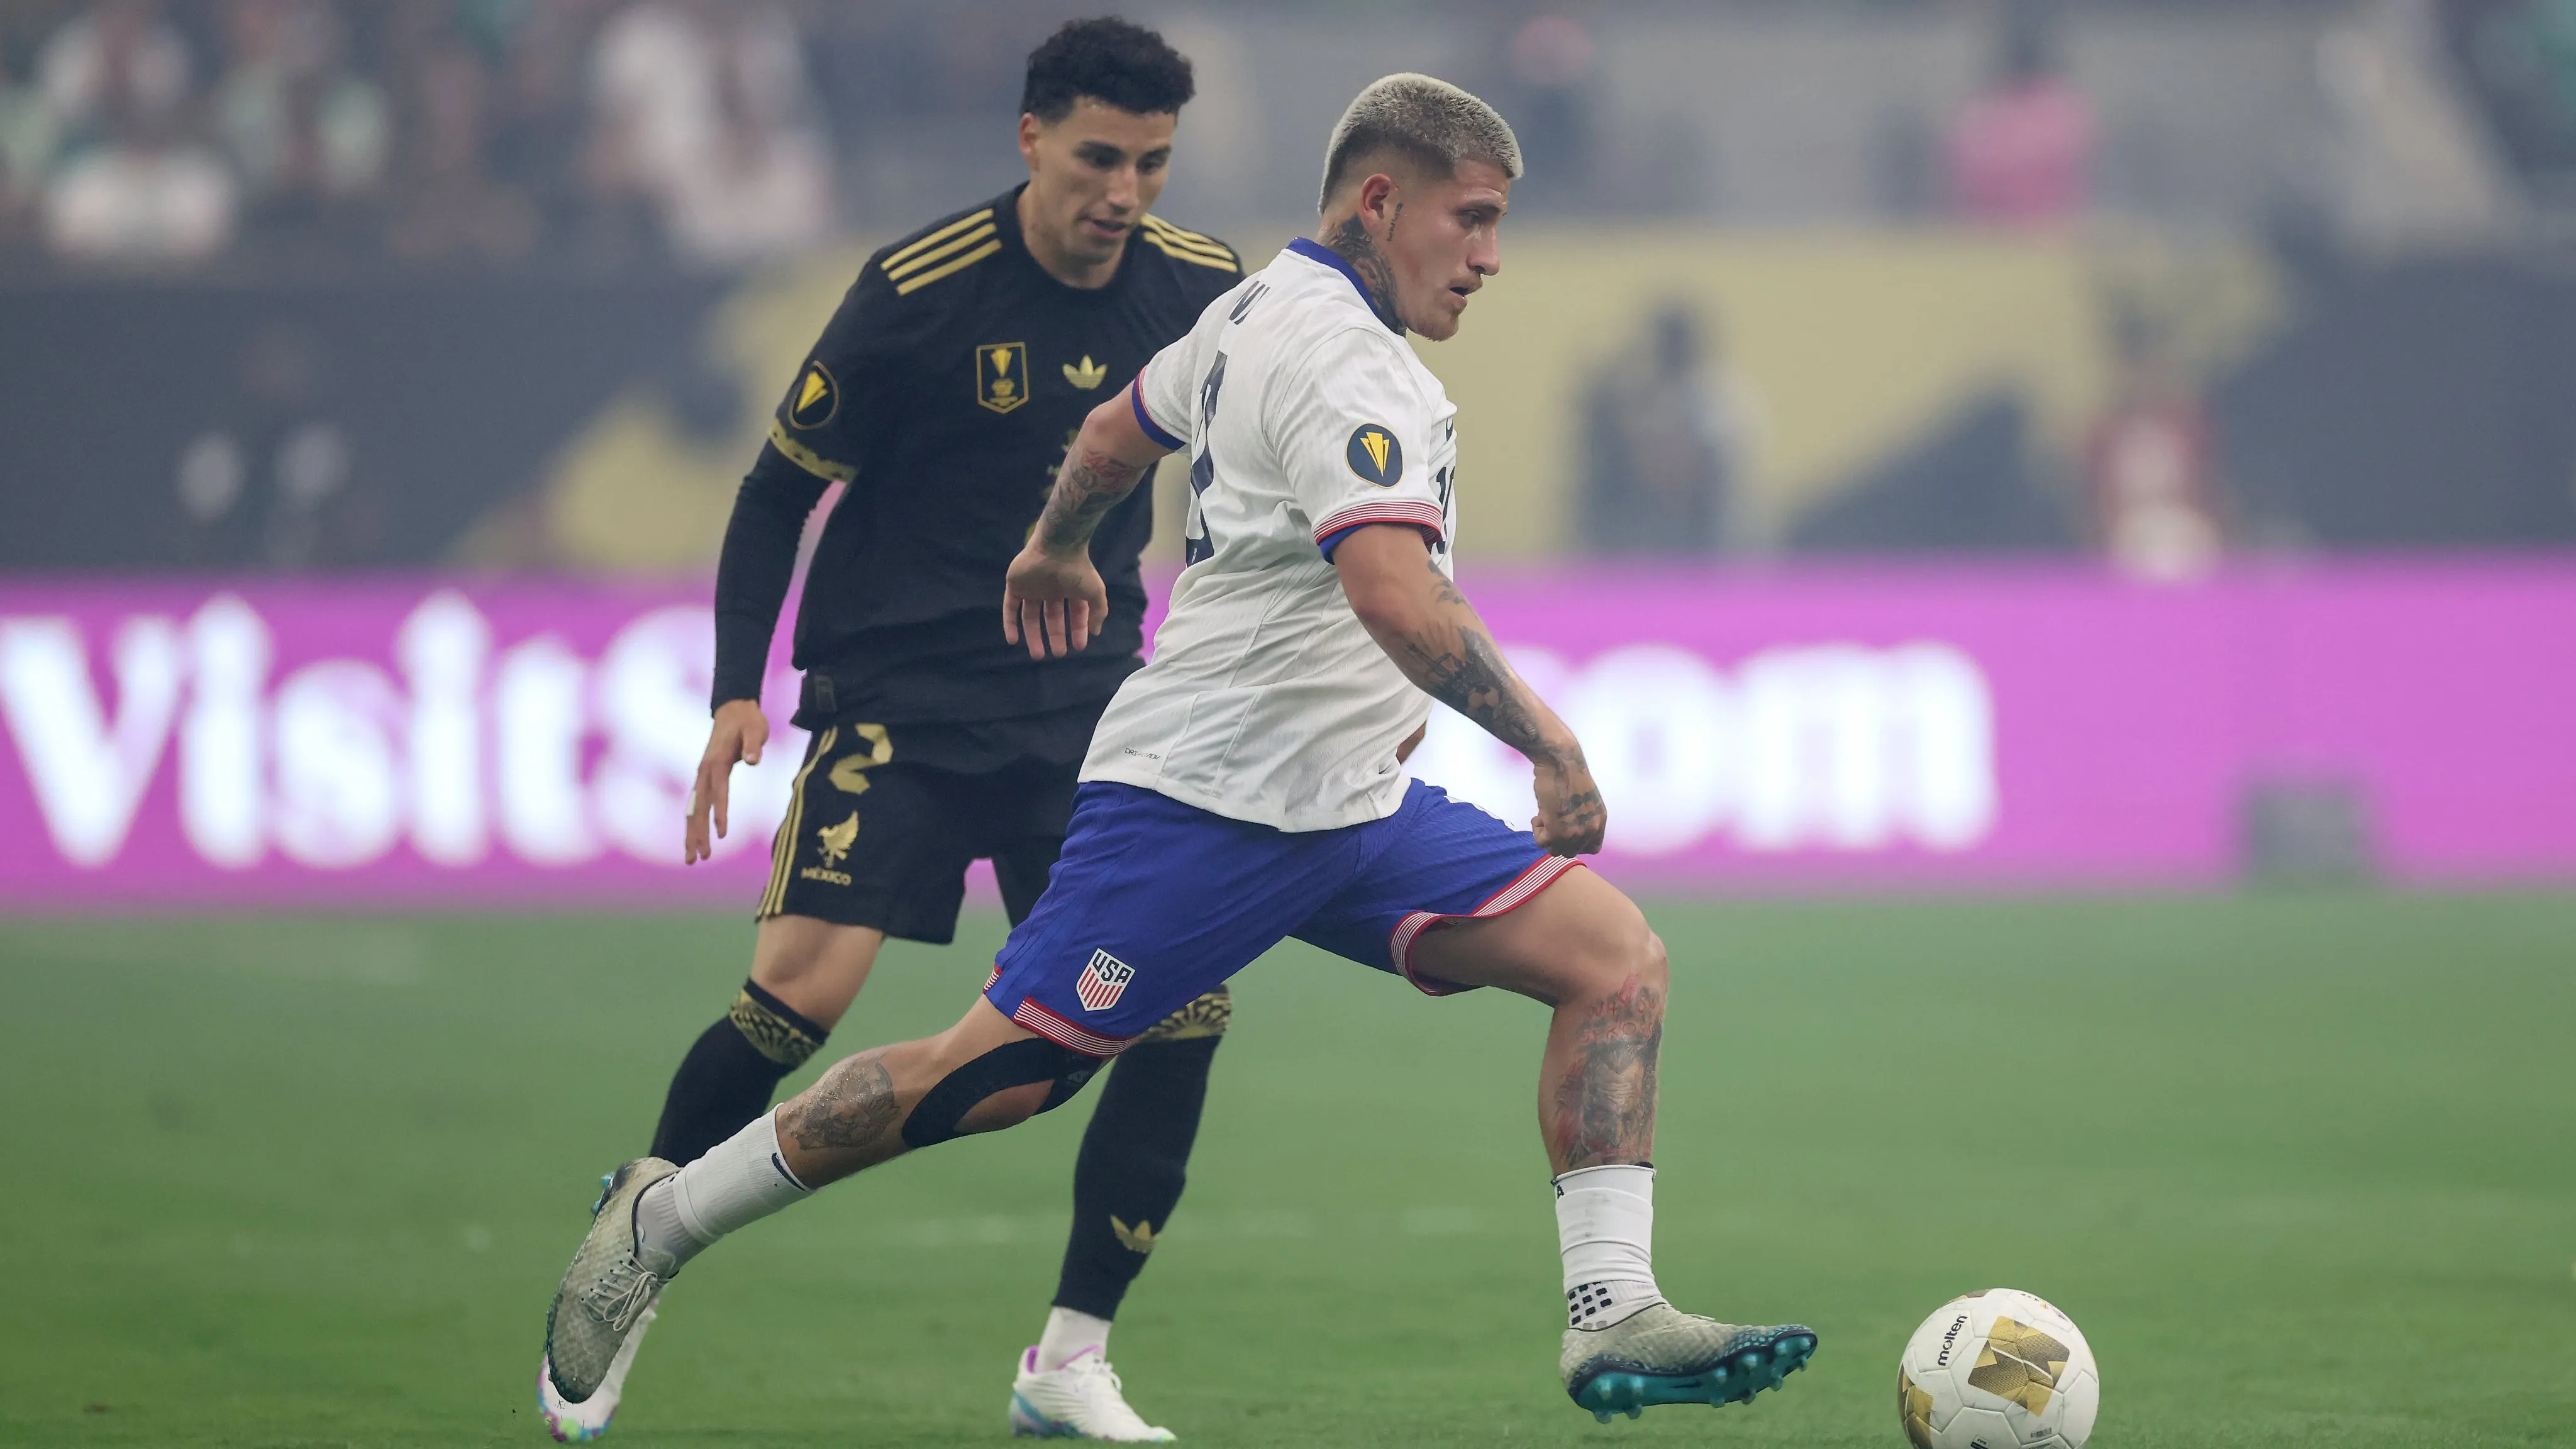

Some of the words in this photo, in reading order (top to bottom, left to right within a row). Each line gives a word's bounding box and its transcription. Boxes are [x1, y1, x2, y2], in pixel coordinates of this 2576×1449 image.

[828, 723, 894, 795] 2
[1092, 952, 1132, 983] USA
[1937, 1315, 1968, 1367] molten
